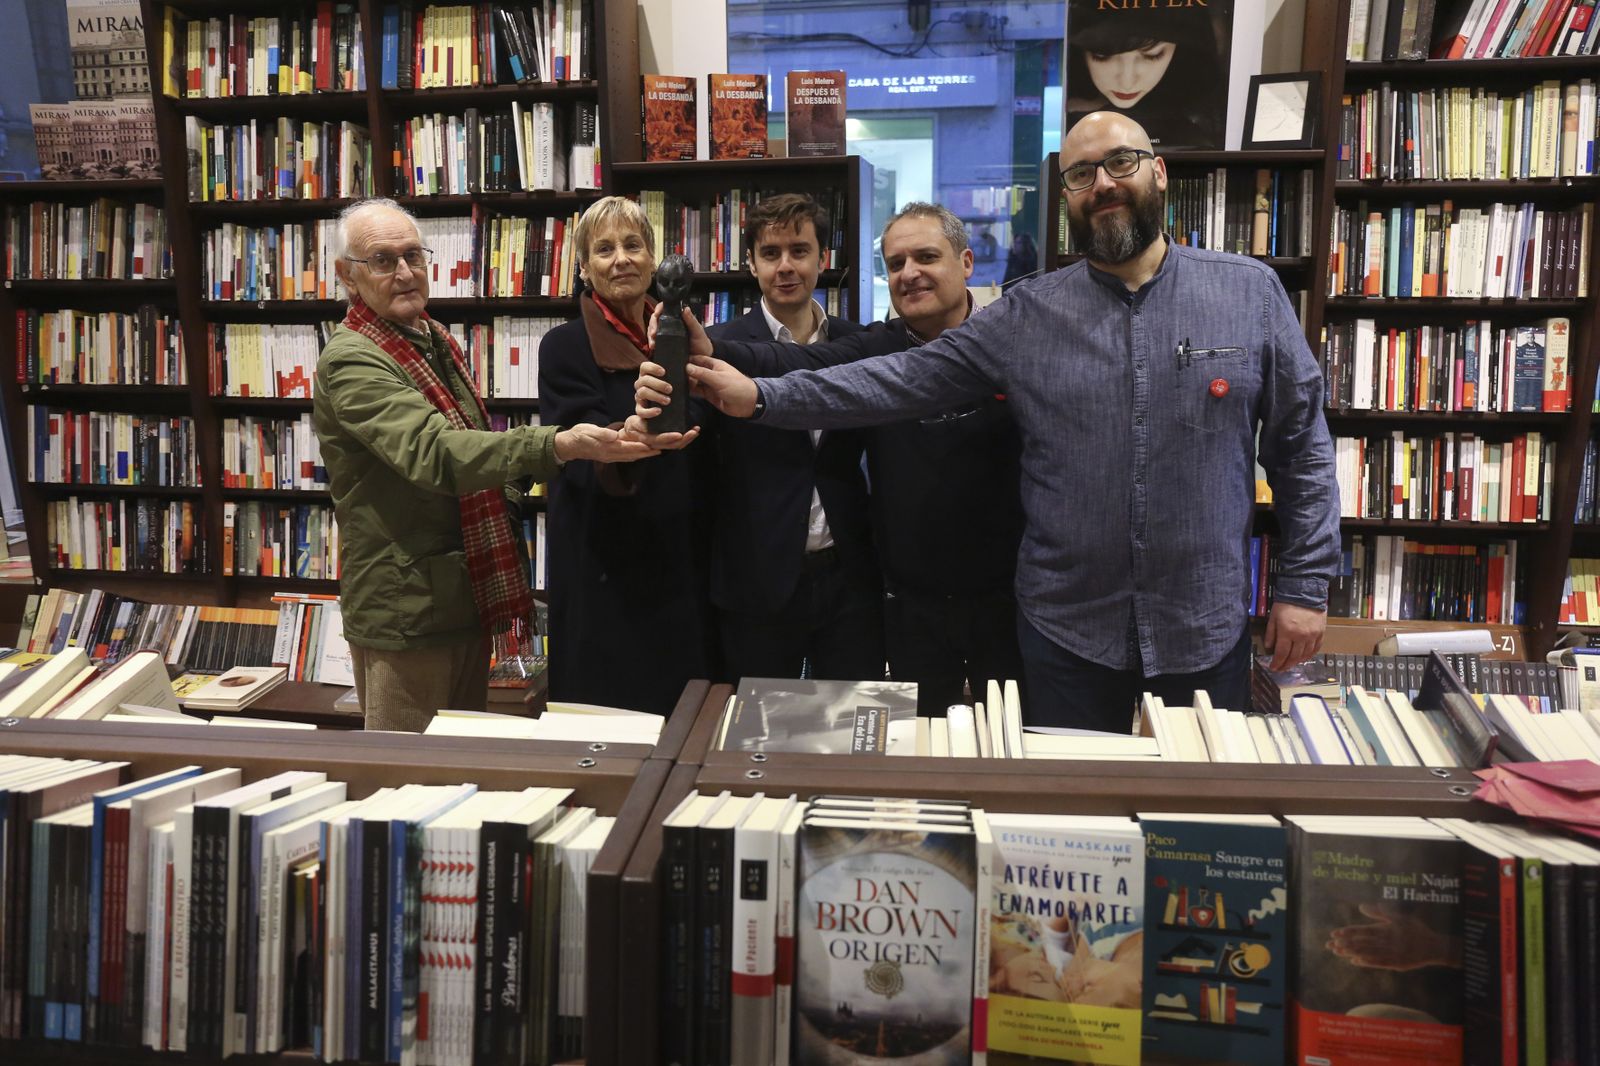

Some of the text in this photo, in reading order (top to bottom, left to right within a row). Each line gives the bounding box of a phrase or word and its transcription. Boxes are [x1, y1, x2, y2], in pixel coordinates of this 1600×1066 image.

[848, 76, 976, 87] CASA DE LAS TORRES
[648, 92, 658, 100] LA
[716, 90, 725, 98] LA
[857, 716, 866, 725] Era
[867, 710, 878, 734] Cuentos
[856, 727, 865, 736] del
[866, 735, 875, 744] de
[1003, 833, 1132, 854] ESTELLE MASKAME
[1147, 832, 1176, 845] Paco
[1146, 847, 1283, 867] Camarasa Sangre en
[1328, 852, 1374, 867] Madre
[1004, 864, 1128, 896] ATRÉVETE A
[1206, 865, 1283, 882] los estantes
[1312, 865, 1459, 888] de leche y miel Najat
[486, 891, 495, 901] LA
[854, 878, 922, 904] DAN
[1383, 886, 1459, 904] El Hachmi
[1000, 893, 1132, 924] ENAMORARTE
[815, 901, 961, 939] BROWN
[829, 939, 943, 965] ORIGEN
